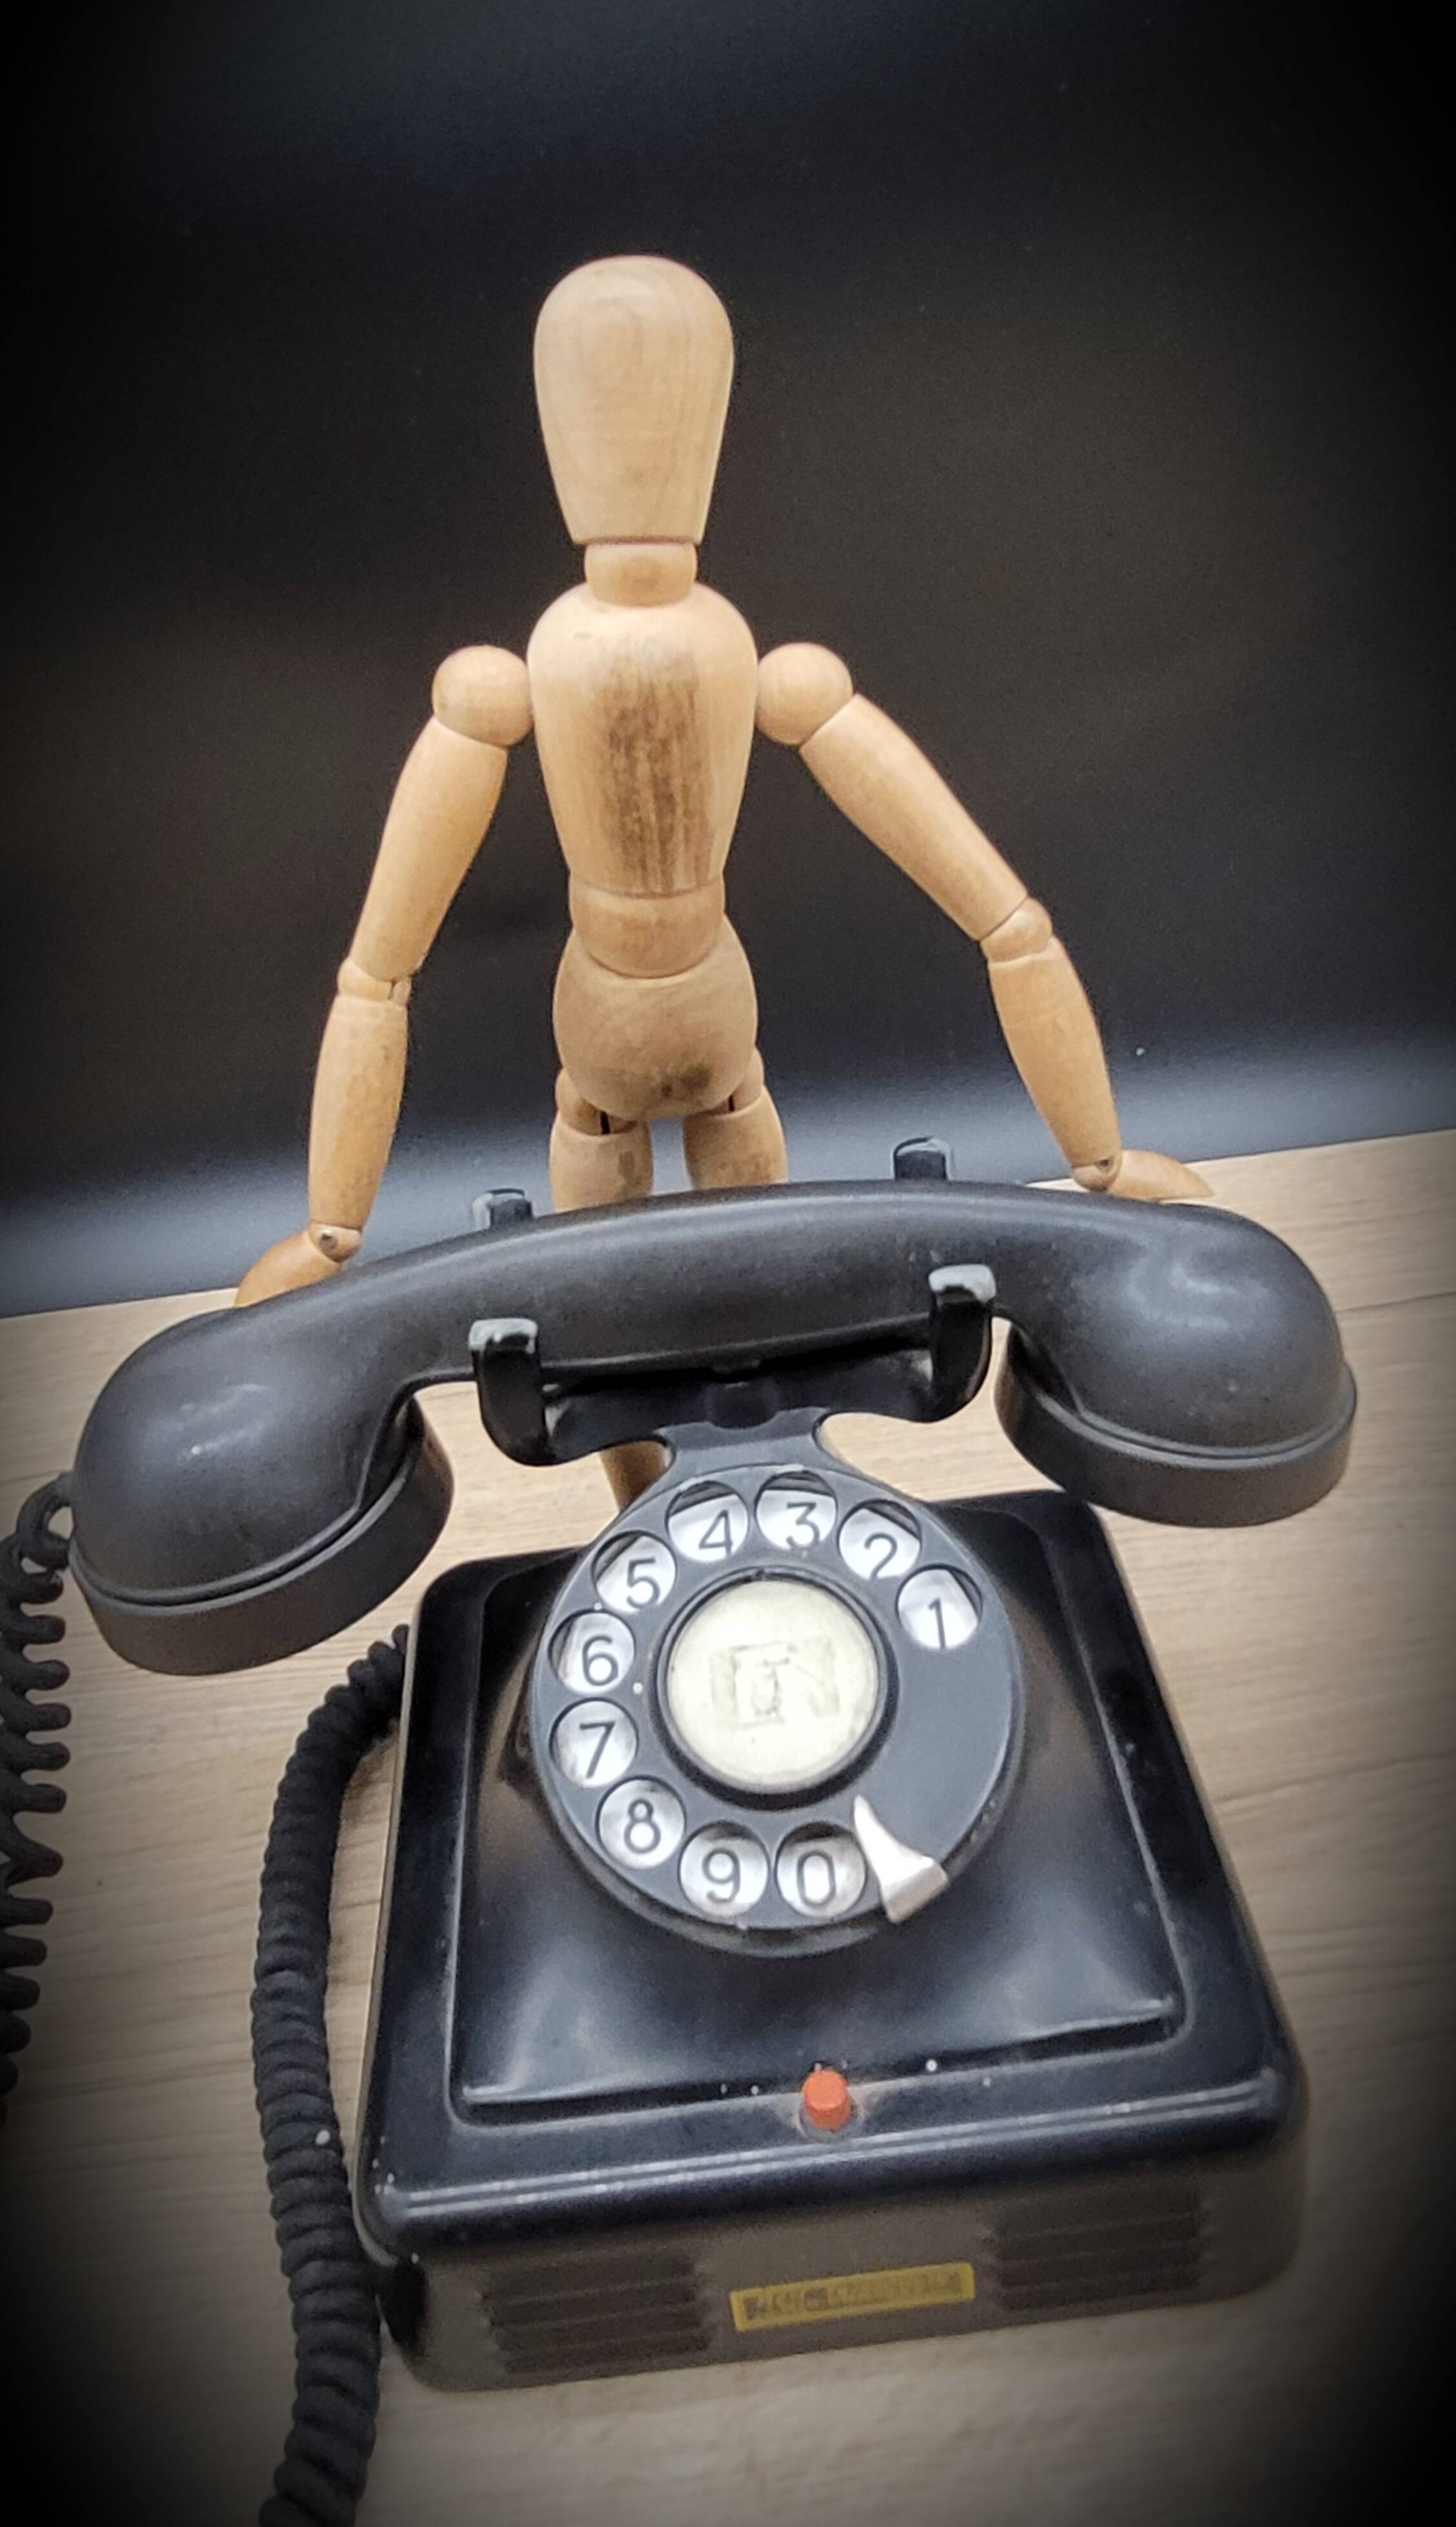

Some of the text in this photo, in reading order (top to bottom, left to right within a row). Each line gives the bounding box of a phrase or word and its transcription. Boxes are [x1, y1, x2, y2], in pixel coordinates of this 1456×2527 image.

[698, 1509, 734, 1556] 4
[785, 1501, 820, 1549] 3
[864, 1532, 898, 1579] 2
[626, 1556, 660, 1609] 5
[928, 1598, 946, 1650] 1
[581, 1635, 618, 1686] 6
[580, 1720, 616, 1779] 7
[623, 1798, 661, 1854] 8
[702, 1847, 741, 1903] 9
[796, 1849, 836, 1907] 0
